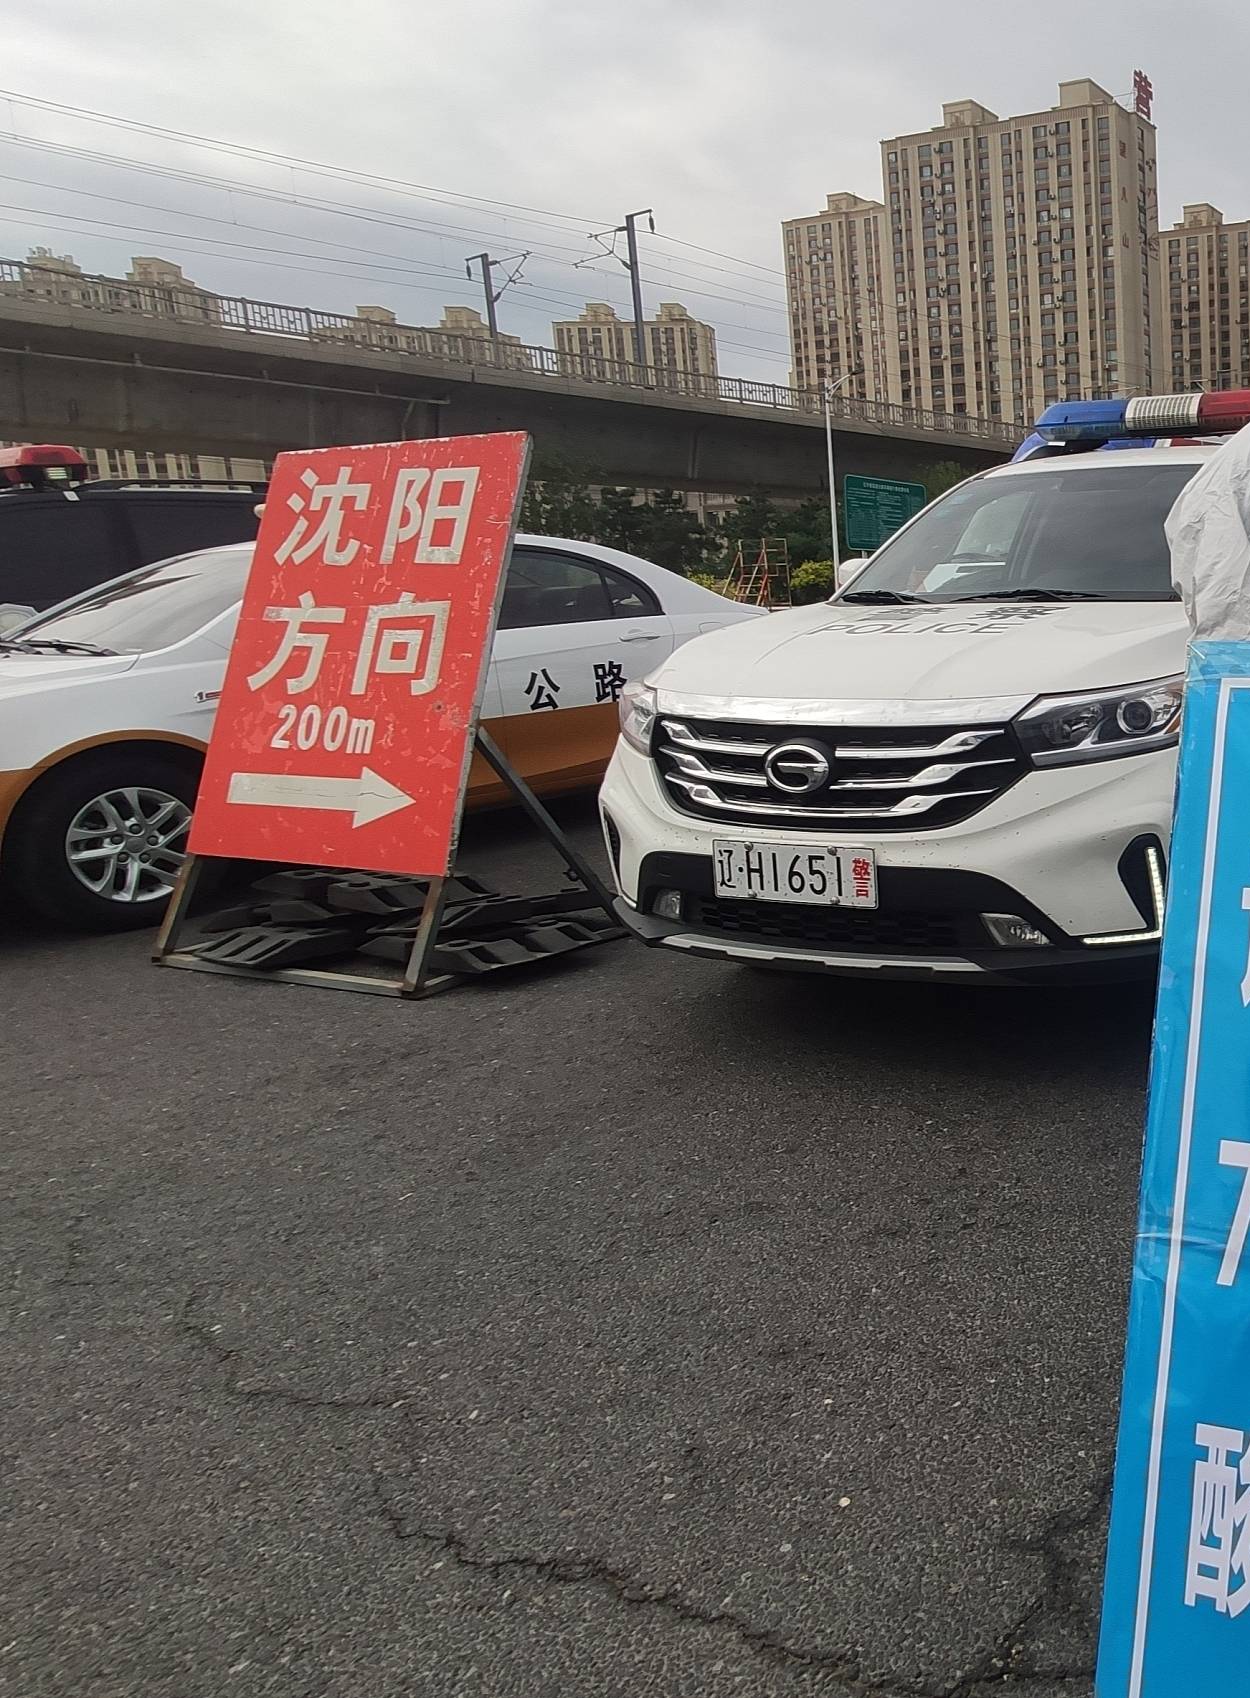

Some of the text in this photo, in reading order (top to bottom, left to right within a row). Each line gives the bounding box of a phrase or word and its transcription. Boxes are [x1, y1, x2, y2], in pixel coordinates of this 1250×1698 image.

[273, 466, 480, 566] 沈阳
[247, 590, 451, 695] 方向
[807, 622, 1025, 635] POLICE
[524, 661, 627, 711] 公路
[270, 704, 375, 754] 200m
